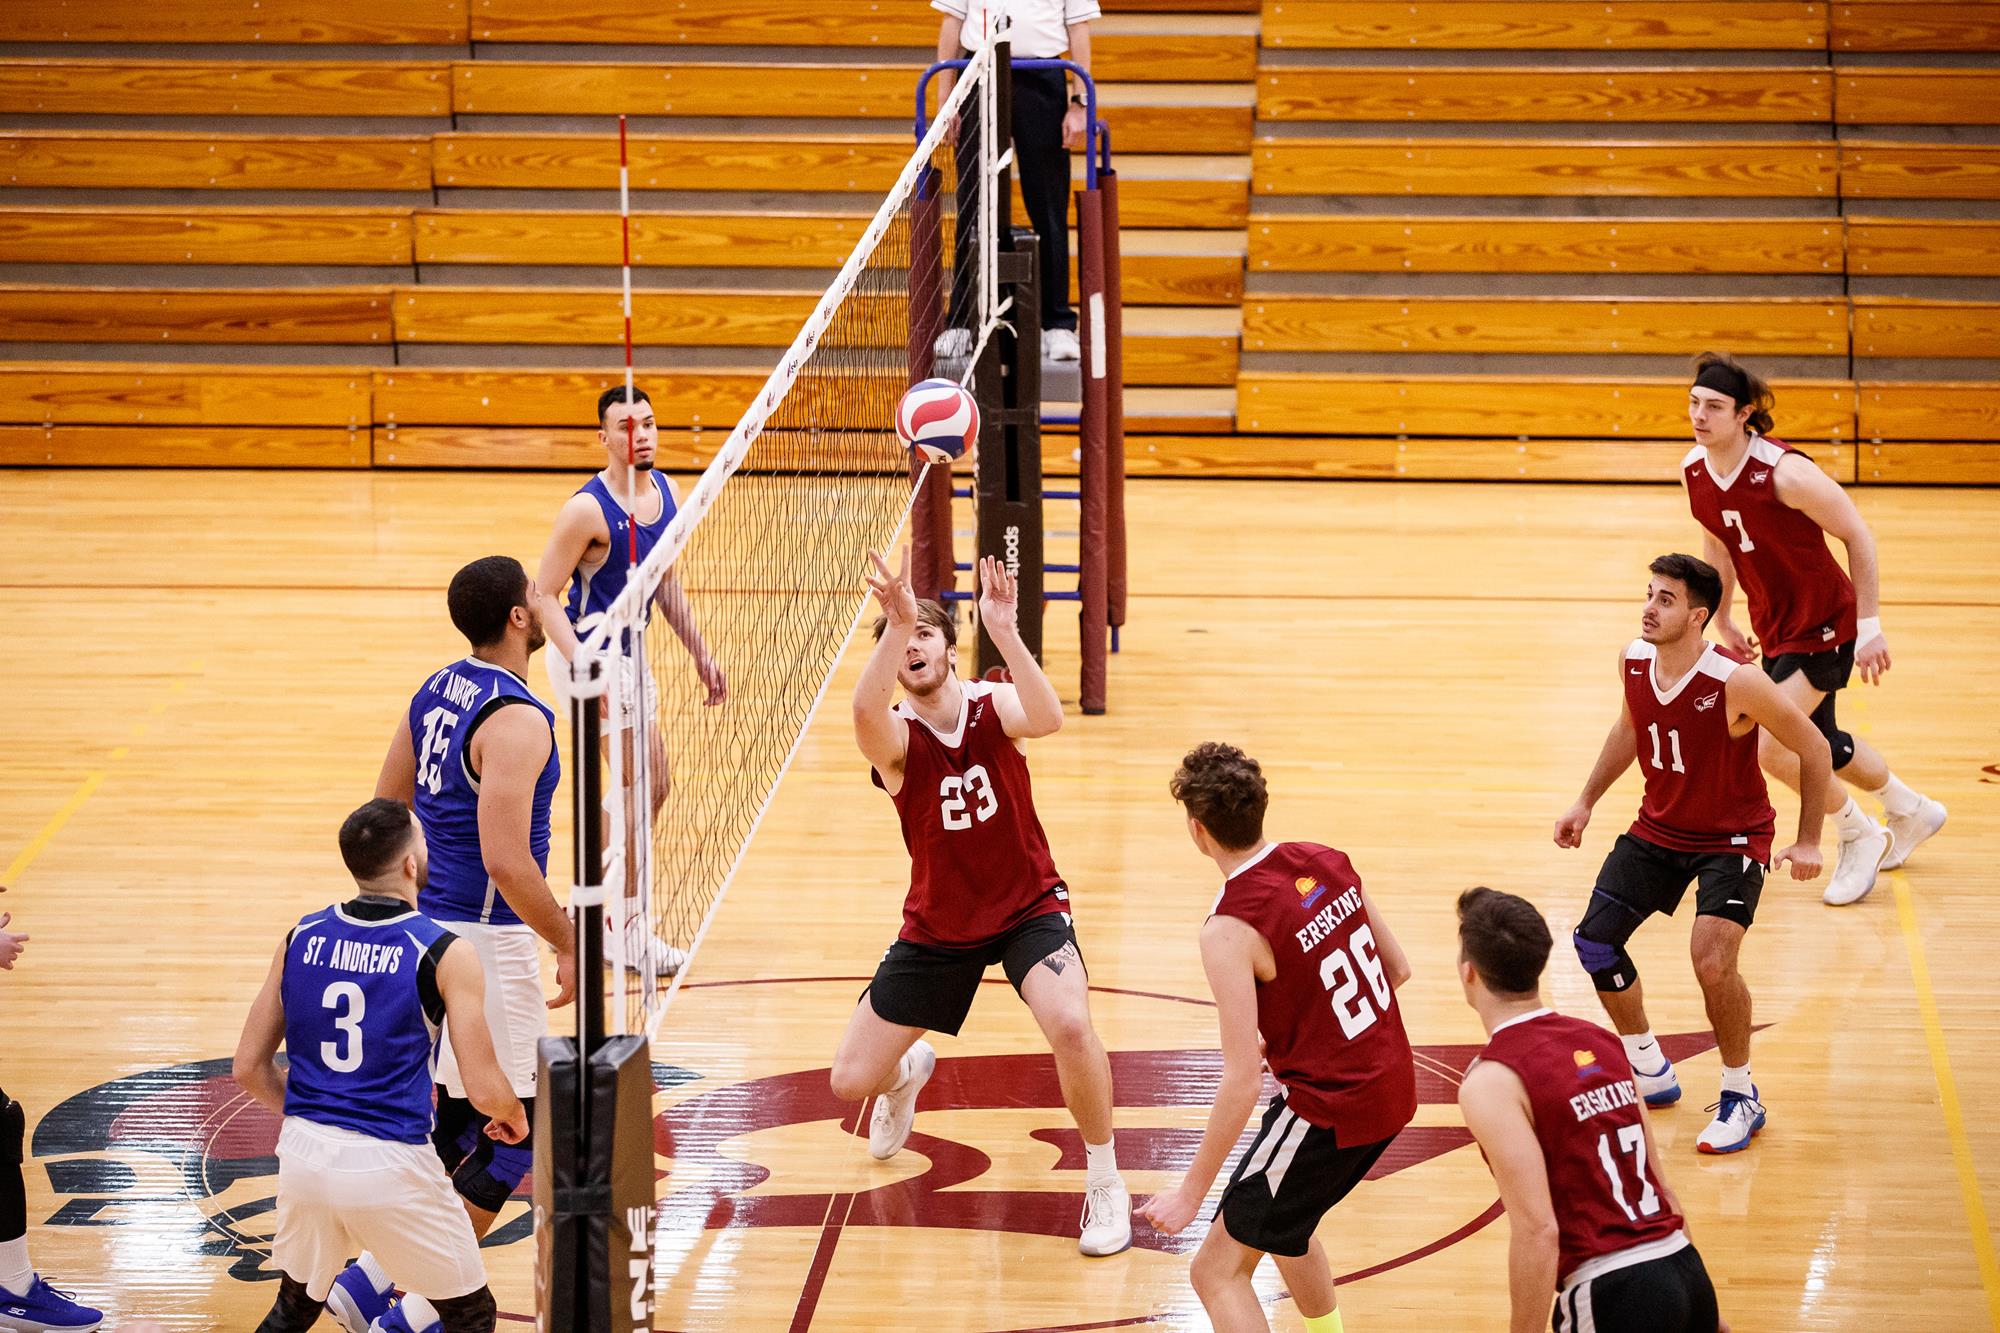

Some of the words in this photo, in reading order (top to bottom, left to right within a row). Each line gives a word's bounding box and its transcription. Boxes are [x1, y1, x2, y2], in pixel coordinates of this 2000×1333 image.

[1721, 509, 1755, 553] 7
[417, 706, 459, 795] 15
[1648, 722, 1686, 774] 11
[940, 764, 998, 831] 23
[1295, 886, 1363, 954] ERSKINE
[303, 936, 327, 967] ST.
[329, 939, 404, 974] ANDREWS
[1319, 923, 1391, 1041] 26
[320, 981, 366, 1073] 3
[1569, 1079, 1638, 1122] ERSKINE
[1597, 1123, 1661, 1222] 17
